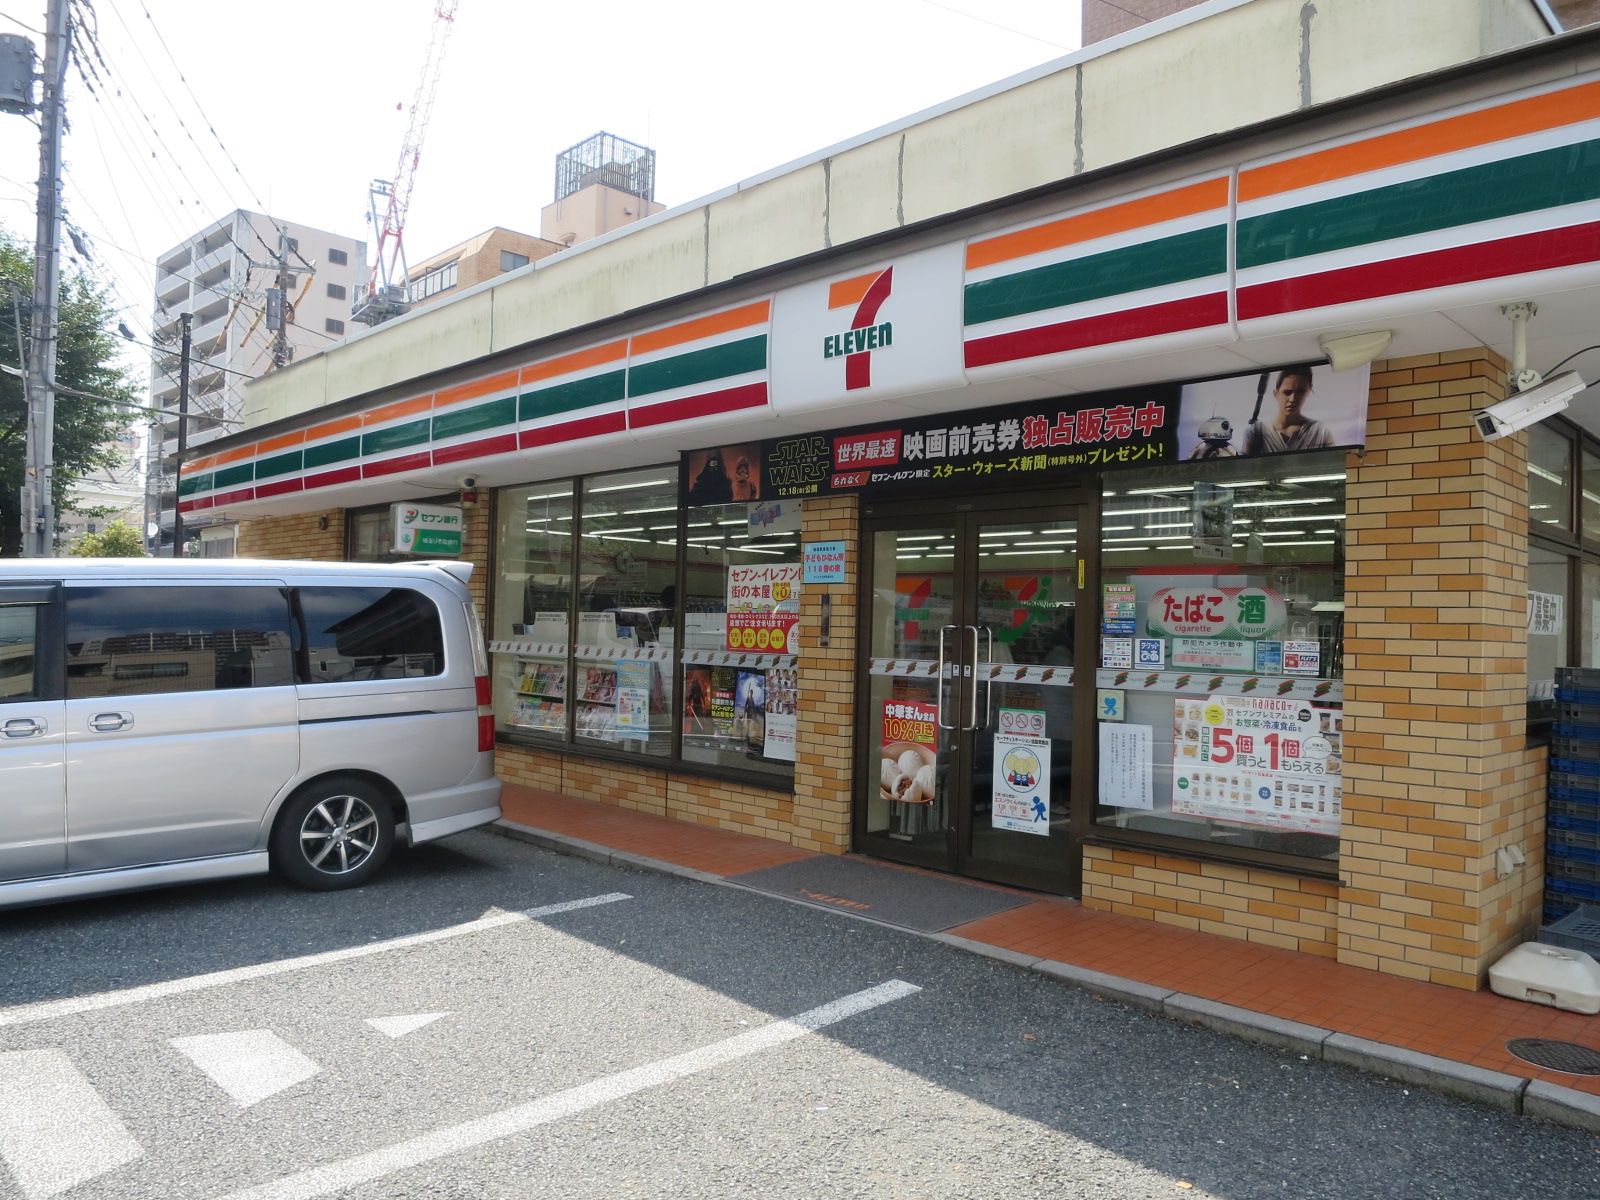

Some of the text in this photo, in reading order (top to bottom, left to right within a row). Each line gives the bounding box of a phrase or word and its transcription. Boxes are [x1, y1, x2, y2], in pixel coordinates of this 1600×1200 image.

[828, 265, 894, 391] 7
[823, 321, 893, 359] ELEVEN
[768, 436, 830, 462] STAR
[837, 437, 897, 464] 世界最速
[768, 461, 830, 486] WARS
[833, 473, 860, 485] もれなく
[1163, 593, 1225, 624] たばこ
[1237, 595, 1266, 624] 酒
[1174, 625, 1266, 634] cigarette liquor
[1182, 639, 1244, 648] 防犯カメラ作動中
[1141, 650, 1159, 661] ぴあ
[1236, 709, 1295, 720] セブンプレミアムの
[884, 718, 935, 741] 10%引き
[1236, 754, 1324, 776] 買うと もらえる
